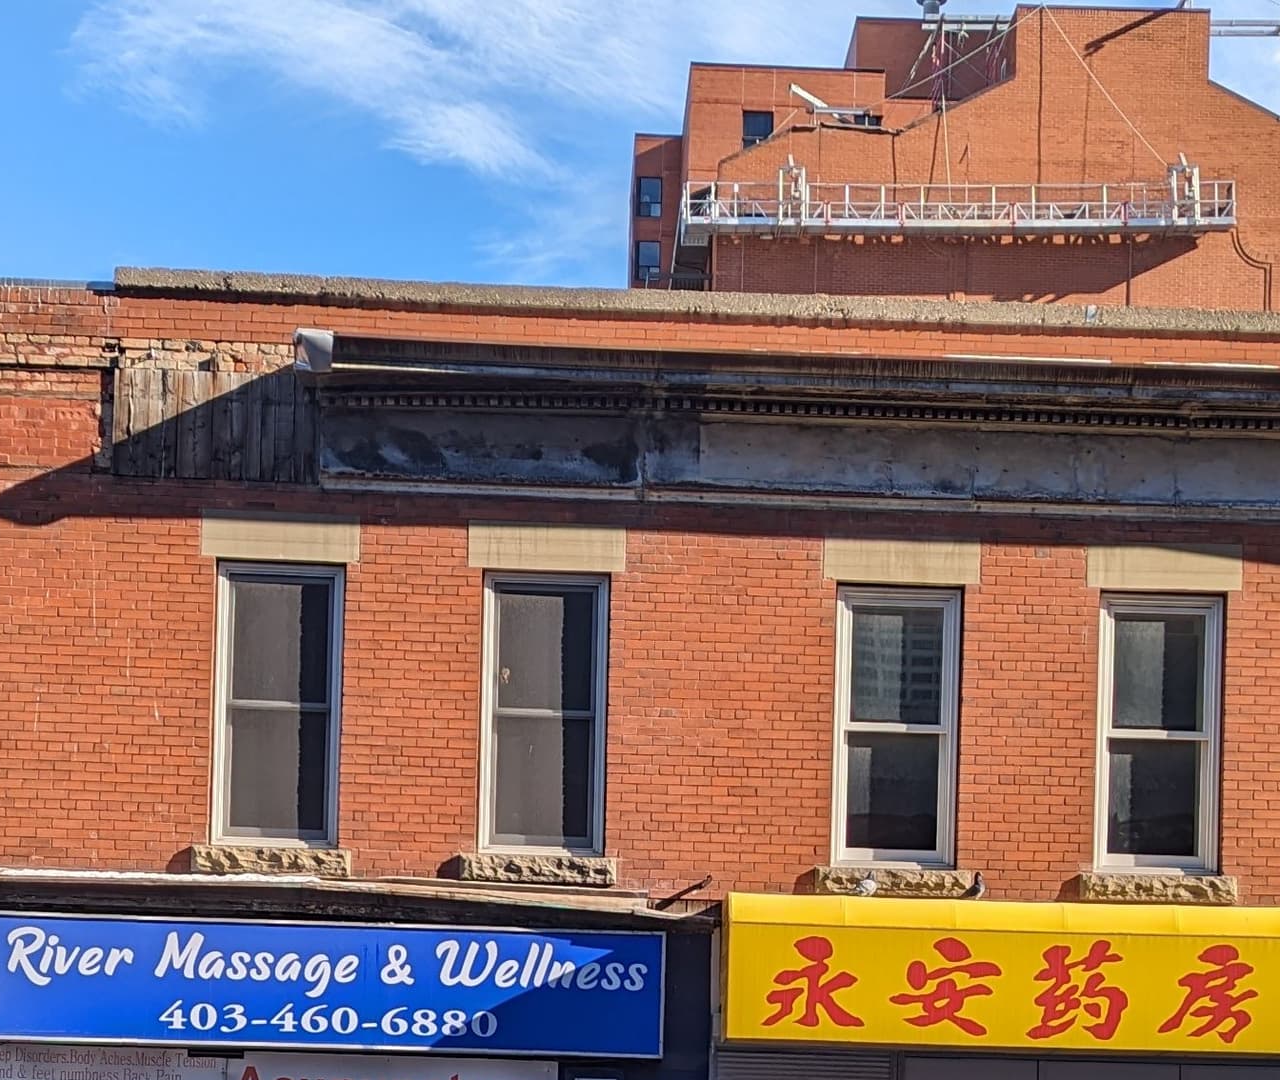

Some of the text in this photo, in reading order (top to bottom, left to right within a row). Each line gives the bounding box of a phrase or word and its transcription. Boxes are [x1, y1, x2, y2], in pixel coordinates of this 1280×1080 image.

[6, 926, 648, 998] River Massage & Wellness
[761, 936, 1261, 1044] 永安药房
[158, 1000, 498, 1037] 403-460-6880
[17, 1064, 26, 1079] &
[32, 1065, 55, 1080] feet
[175, 1053, 216, 1069] Tension
